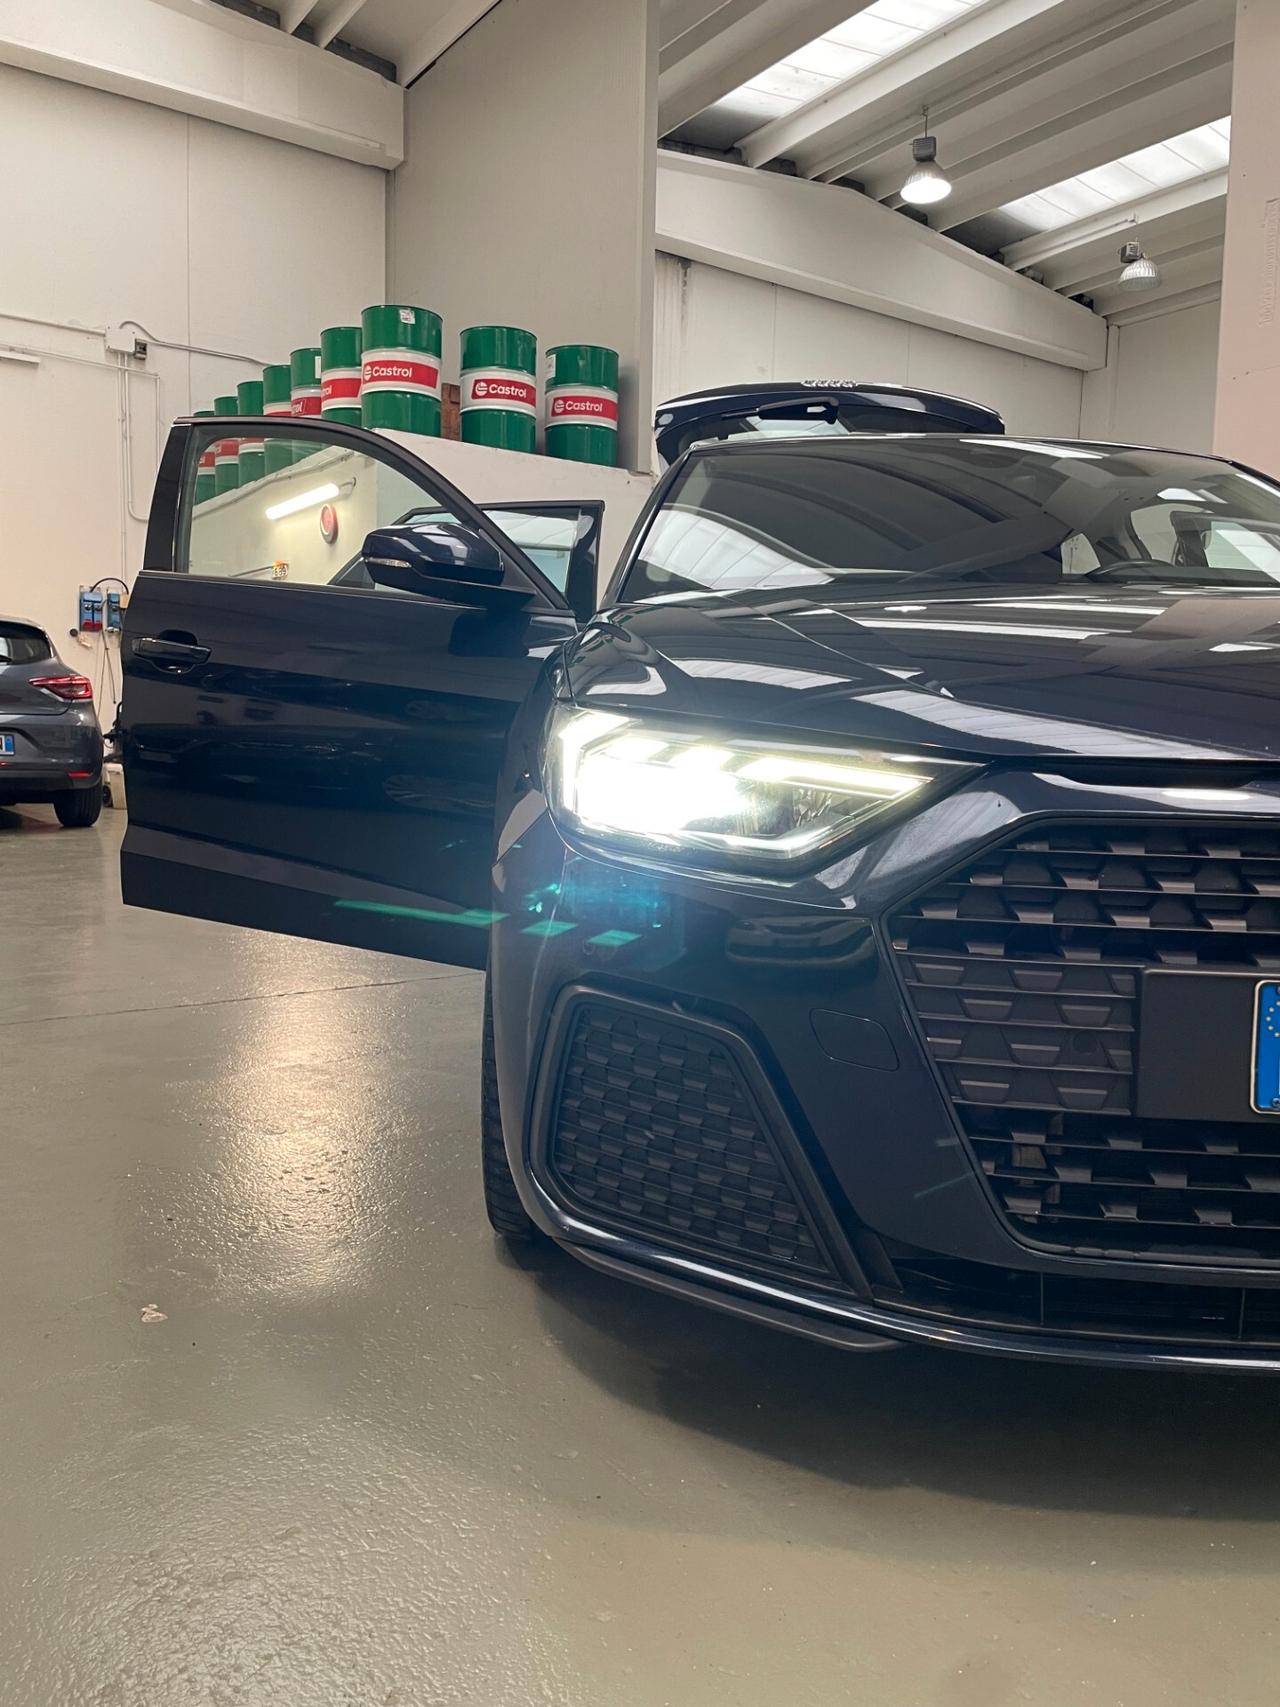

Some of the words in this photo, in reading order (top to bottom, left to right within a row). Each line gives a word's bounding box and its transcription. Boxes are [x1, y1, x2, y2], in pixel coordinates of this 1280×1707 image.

[372, 366, 412, 378] Castrol
[489, 384, 527, 398] Castrol
[565, 401, 603, 412] Castrol
